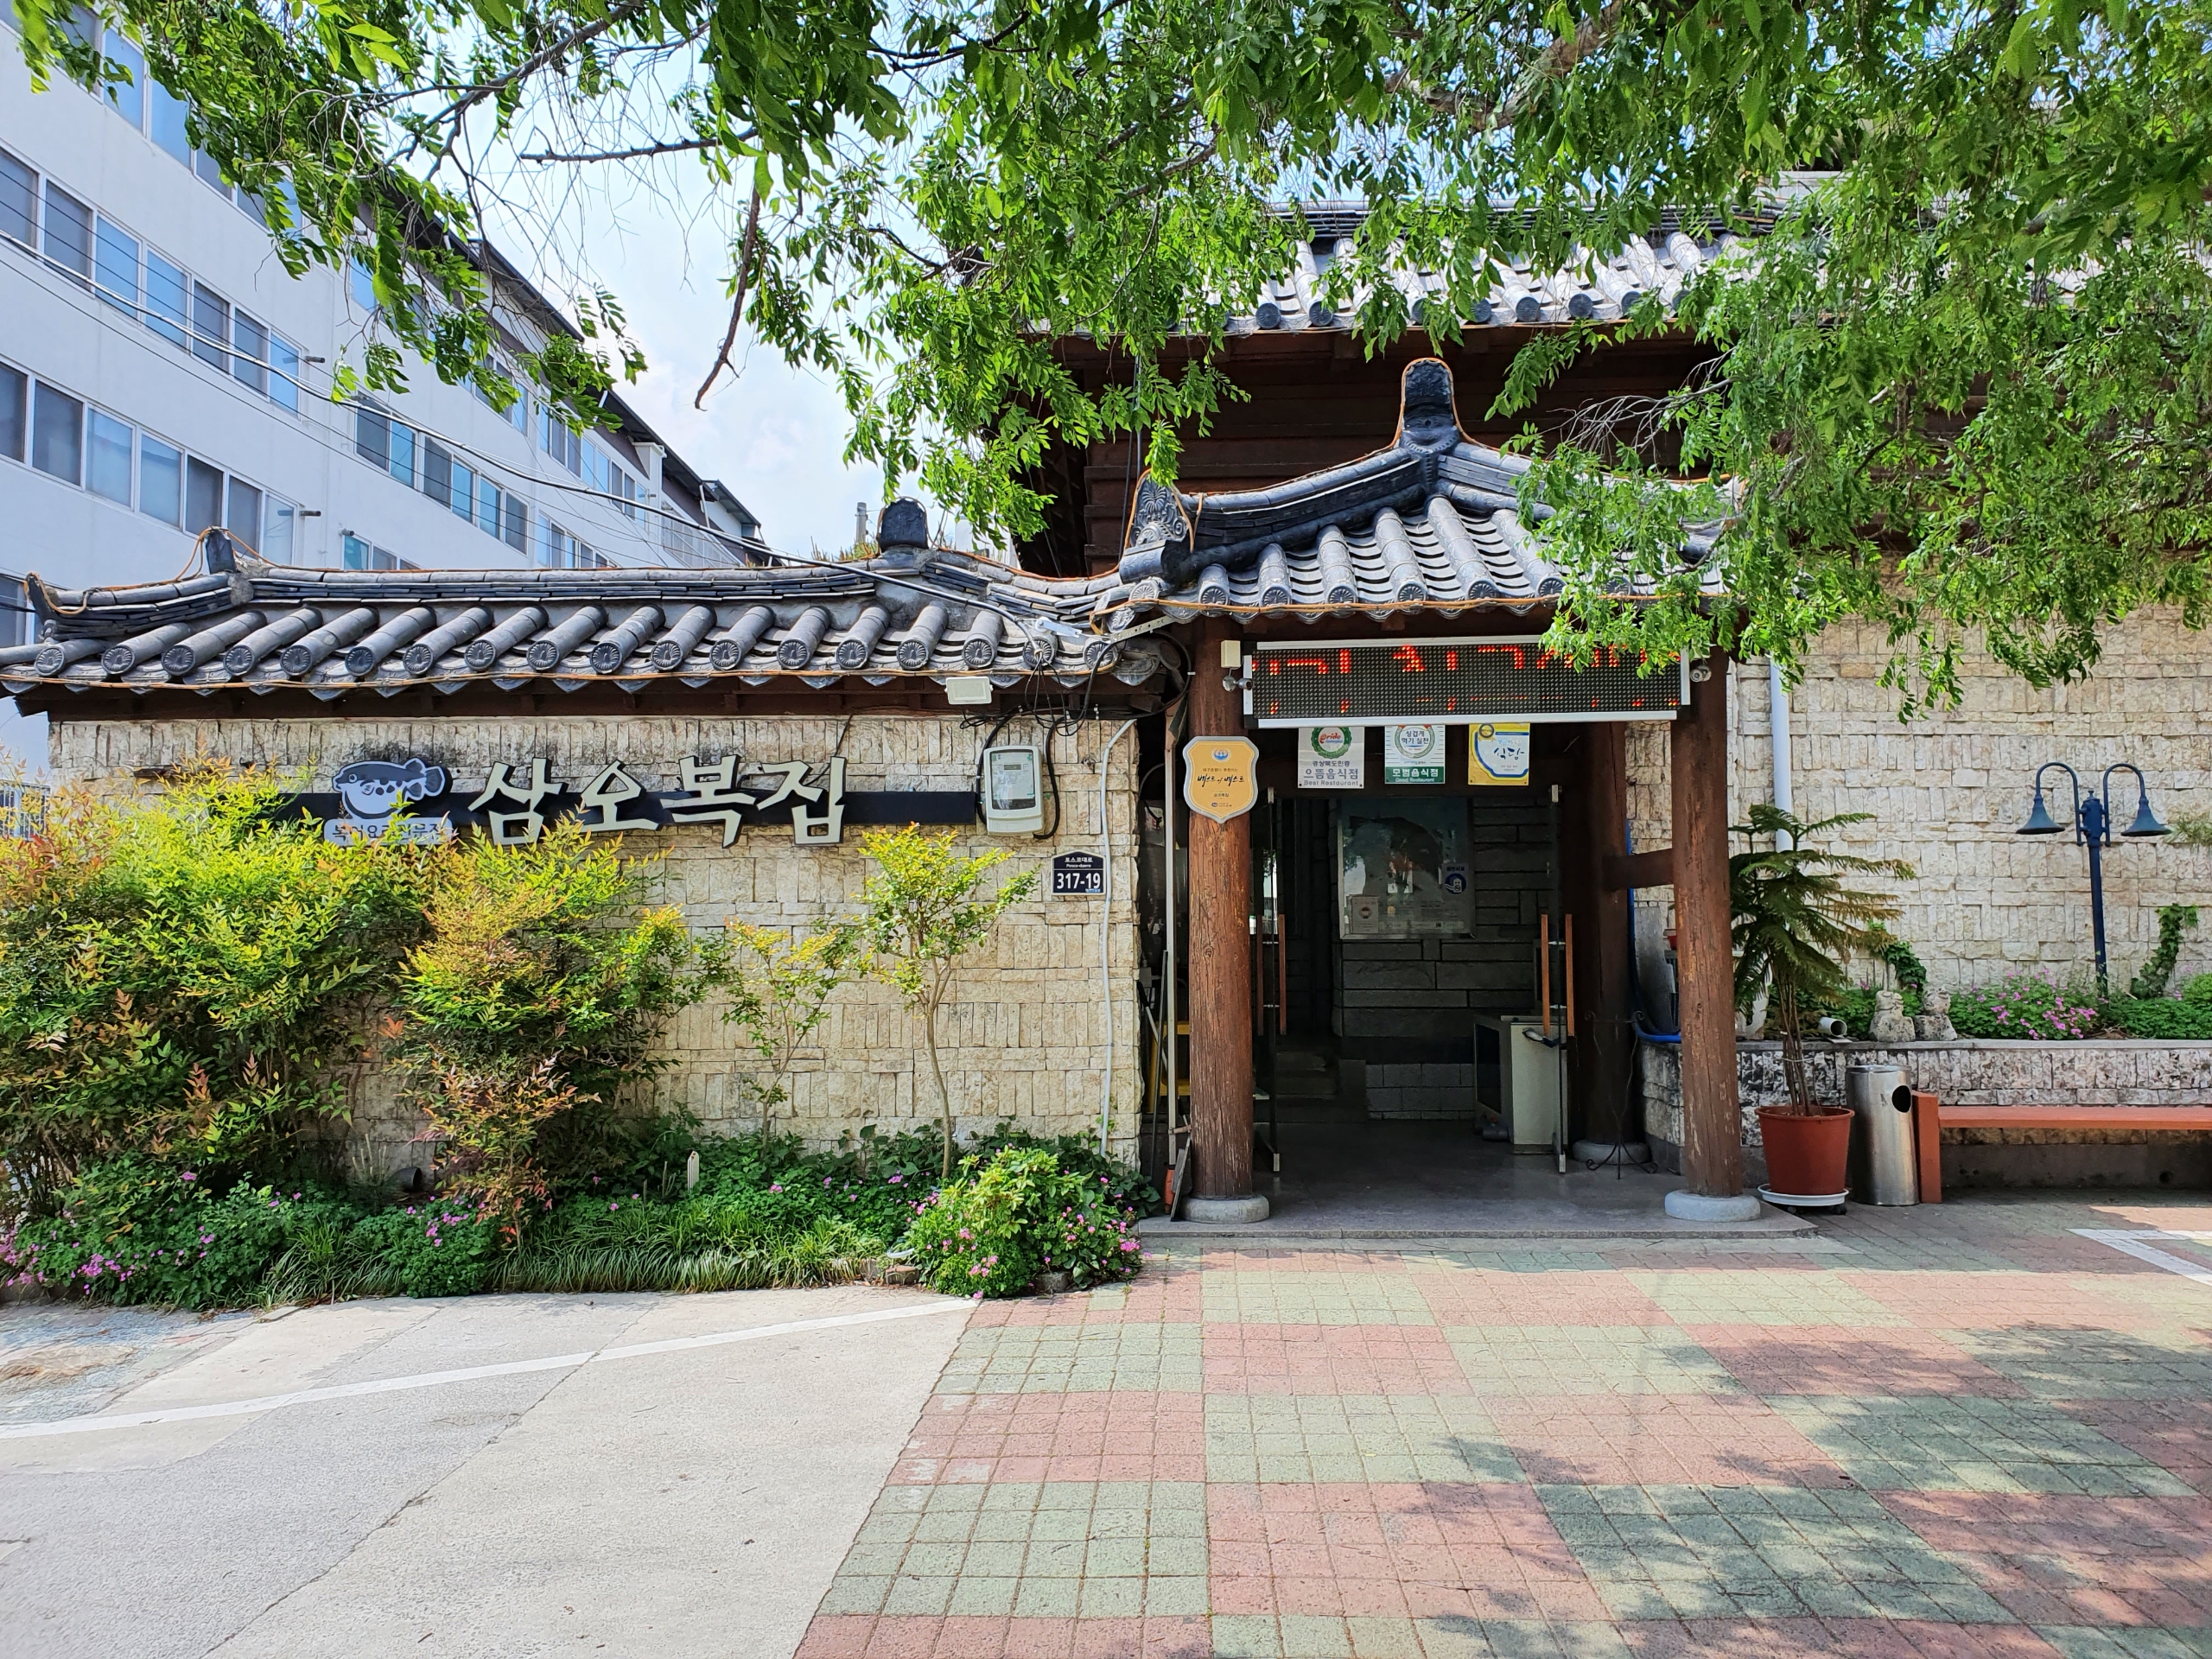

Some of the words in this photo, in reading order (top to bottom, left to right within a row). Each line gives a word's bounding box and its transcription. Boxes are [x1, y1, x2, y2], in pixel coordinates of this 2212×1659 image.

[1494, 747, 1525, 760] 식당
[1304, 768, 1358, 779] 으뜸음식점
[1392, 768, 1439, 777] 모범음식점
[469, 754, 849, 849] 삼오복집
[1057, 873, 1101, 889] 317-19
